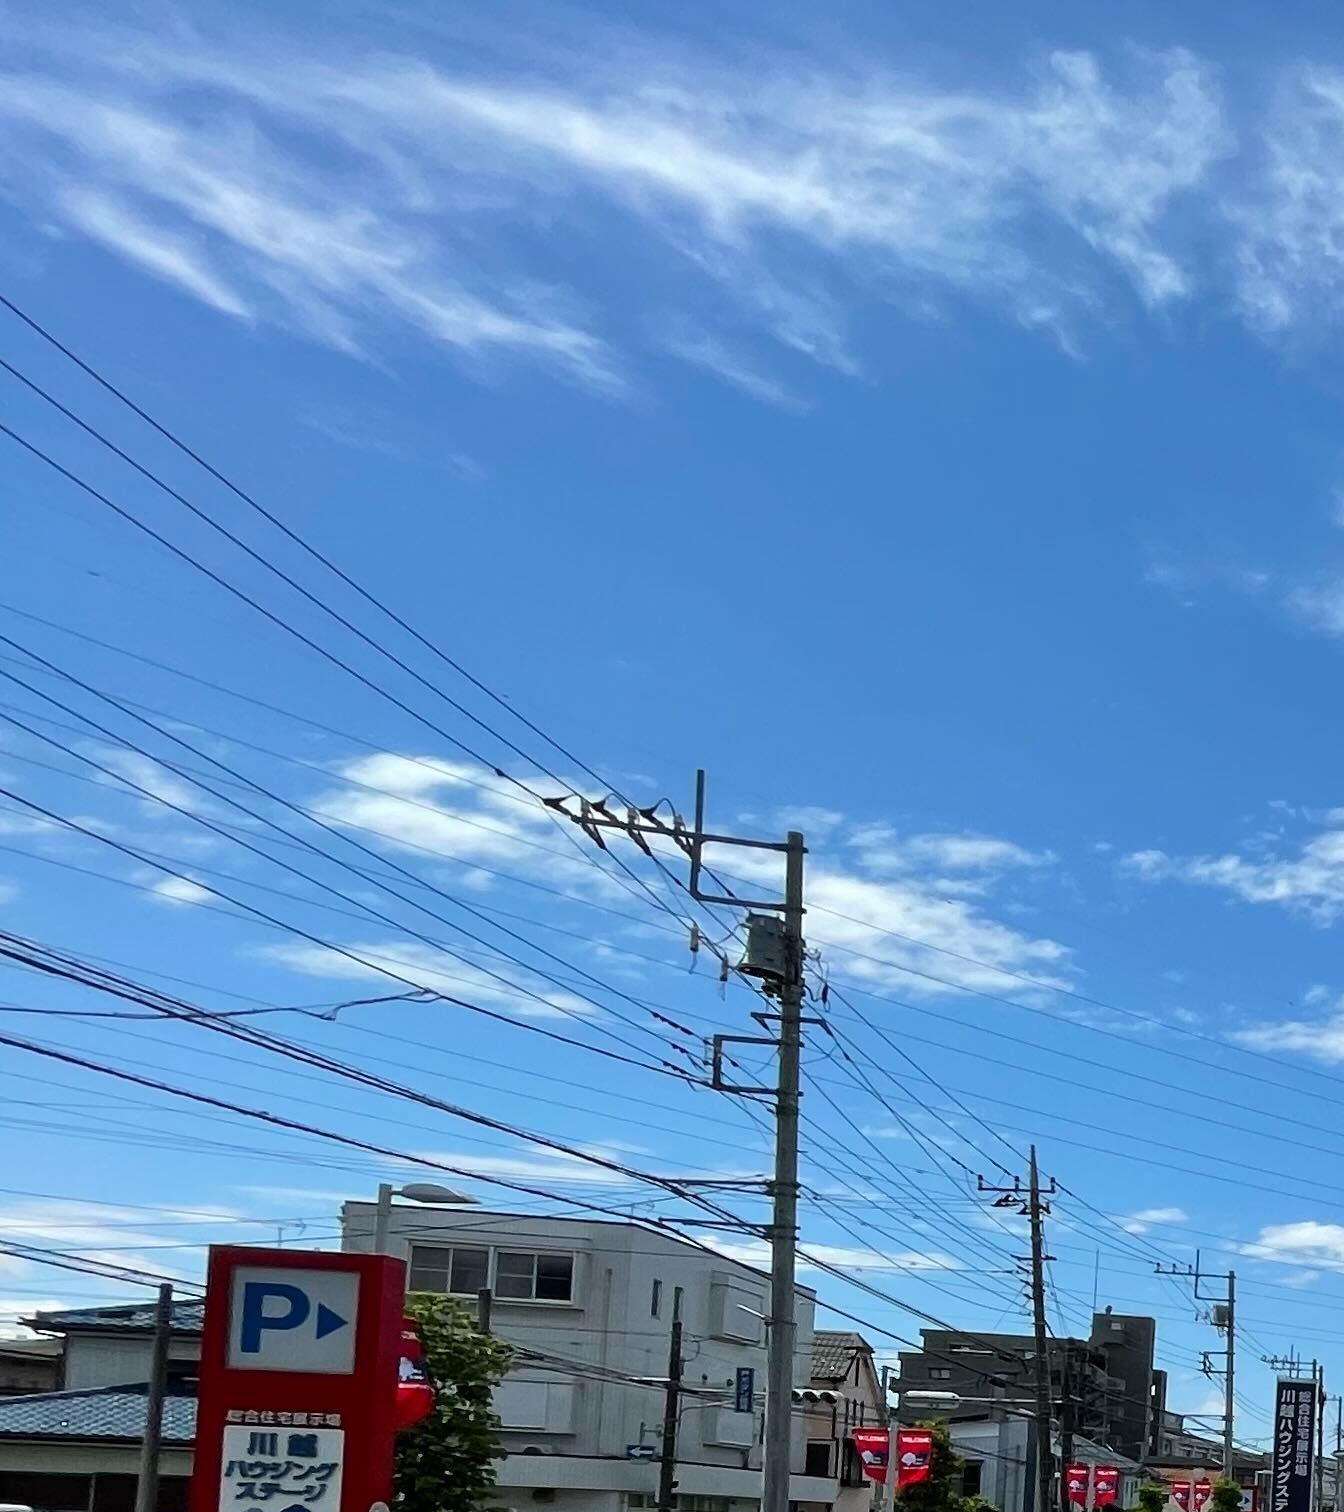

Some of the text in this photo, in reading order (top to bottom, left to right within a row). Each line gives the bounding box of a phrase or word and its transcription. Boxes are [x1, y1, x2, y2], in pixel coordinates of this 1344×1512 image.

[241, 1282, 310, 1353] P
[224, 1460, 338, 1482] ハウジング
[235, 1482, 328, 1502] ステージ
